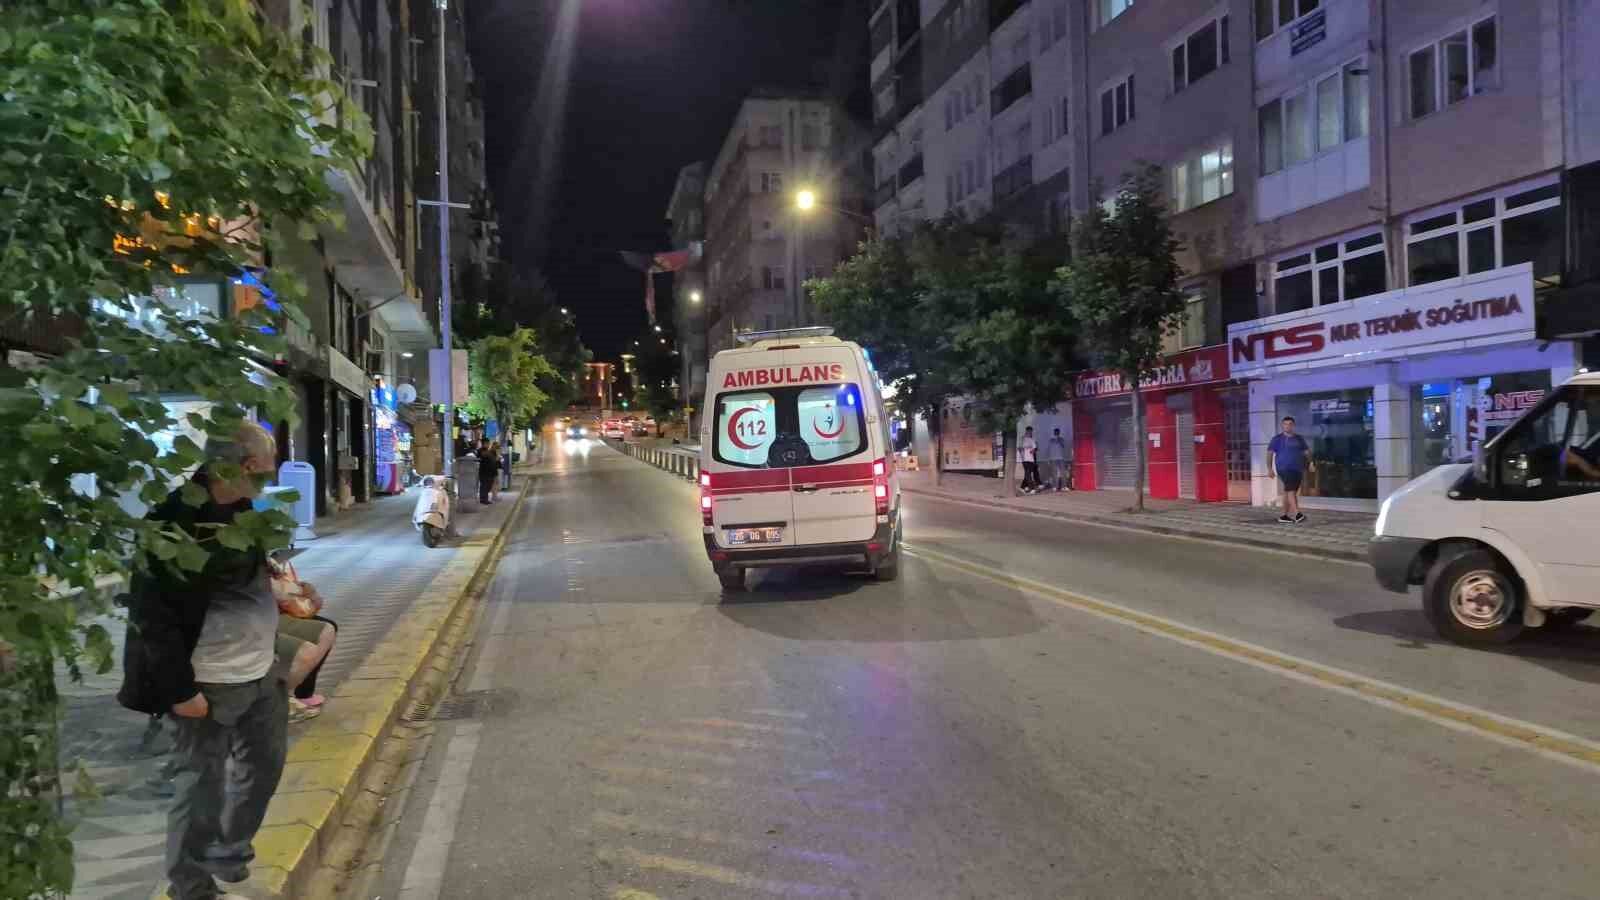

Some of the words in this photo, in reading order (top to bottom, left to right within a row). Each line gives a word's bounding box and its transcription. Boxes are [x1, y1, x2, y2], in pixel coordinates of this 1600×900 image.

[1232, 321, 1325, 363] NTS
[1330, 322, 1361, 343] NUR
[1364, 308, 1422, 337] TEKNİK
[1426, 293, 1522, 328] SOĞUTMA
[723, 364, 844, 388] AMBULANS
[1075, 373, 1121, 398] ÖZTÜRK
[738, 419, 767, 438] 112
